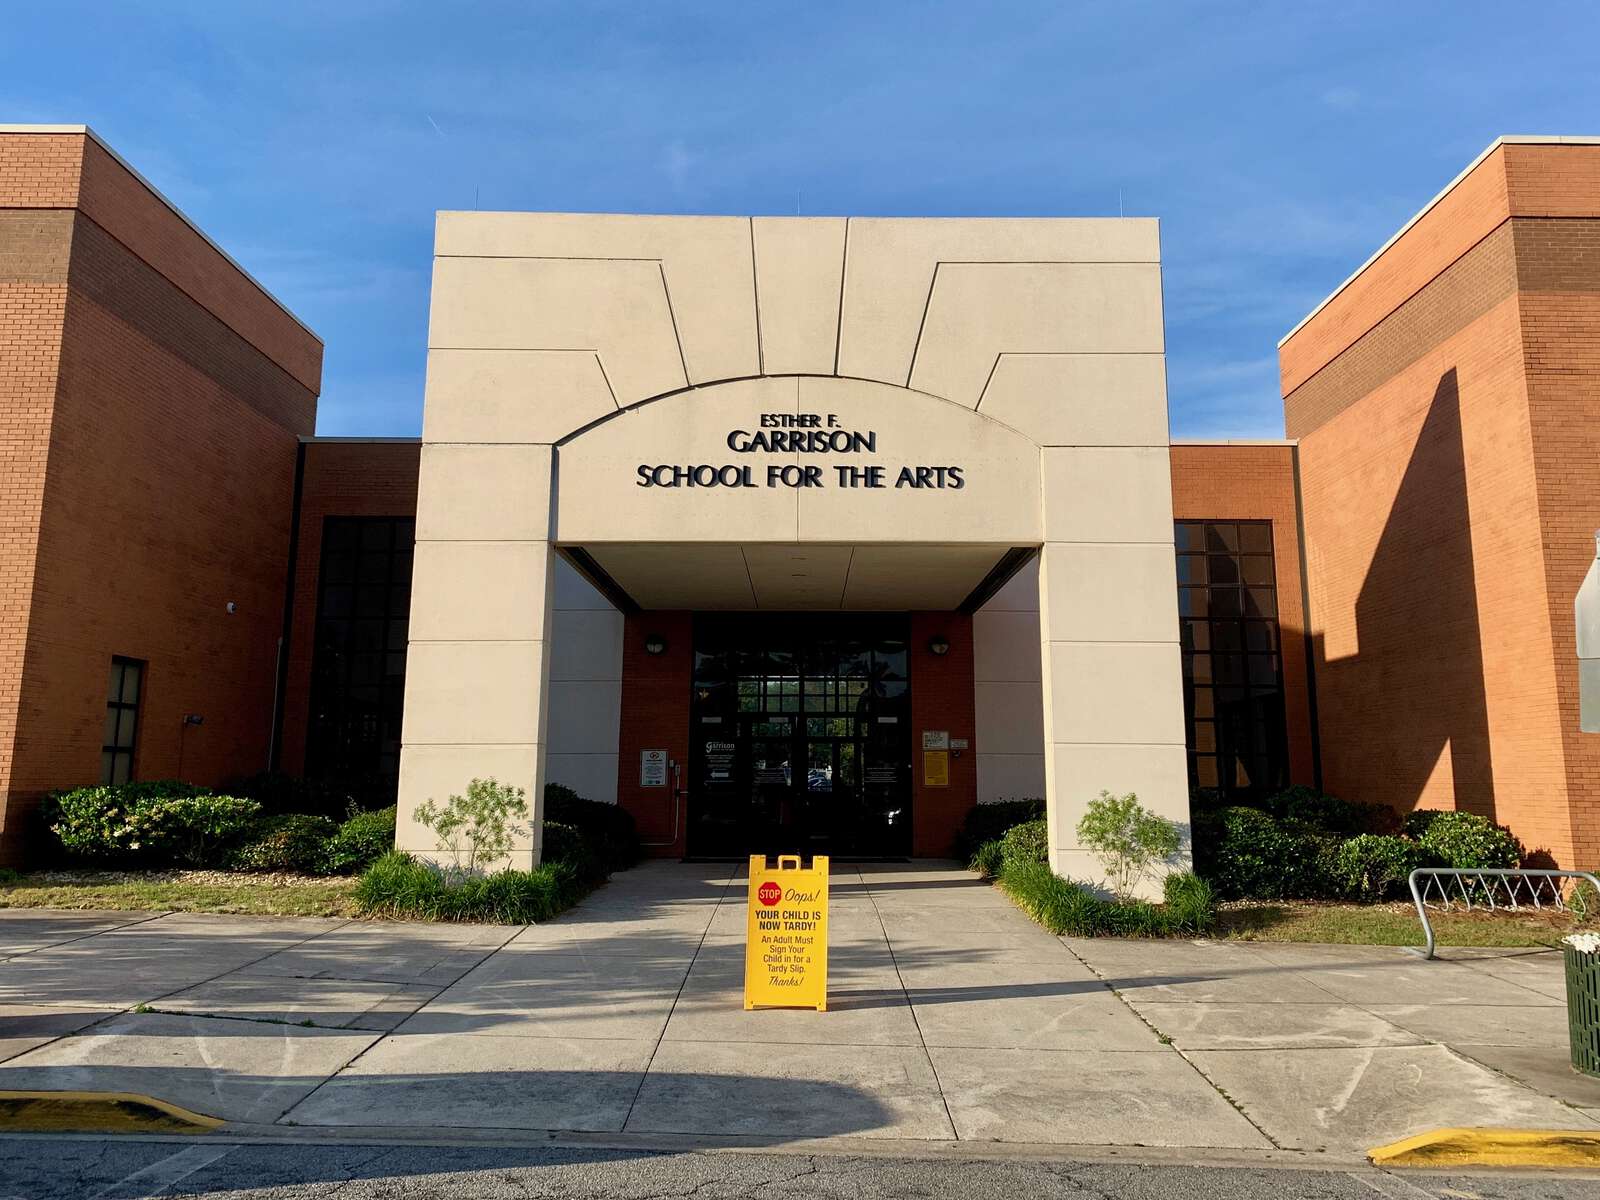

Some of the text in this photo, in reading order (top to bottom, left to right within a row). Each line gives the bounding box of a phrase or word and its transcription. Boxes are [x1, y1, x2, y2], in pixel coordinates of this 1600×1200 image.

[760, 413, 841, 428] ESTHER F.
[727, 430, 876, 453] GARRISON
[636, 464, 965, 489] SCHOOL FOR THE ARTS
[759, 889, 781, 900] STOP
[784, 888, 821, 905] Oops!
[755, 910, 821, 920] YOUR CHILD IS
[759, 921, 816, 931] NOW TARDY!
[761, 935, 814, 945] An Adult Must
[769, 945, 805, 955] Sign Your
[763, 954, 782, 963] Child
[784, 954, 792, 963] in
[793, 955, 804, 963] for
[767, 964, 806, 974] Tardy Slip.
[768, 975, 804, 987] Thanks!
